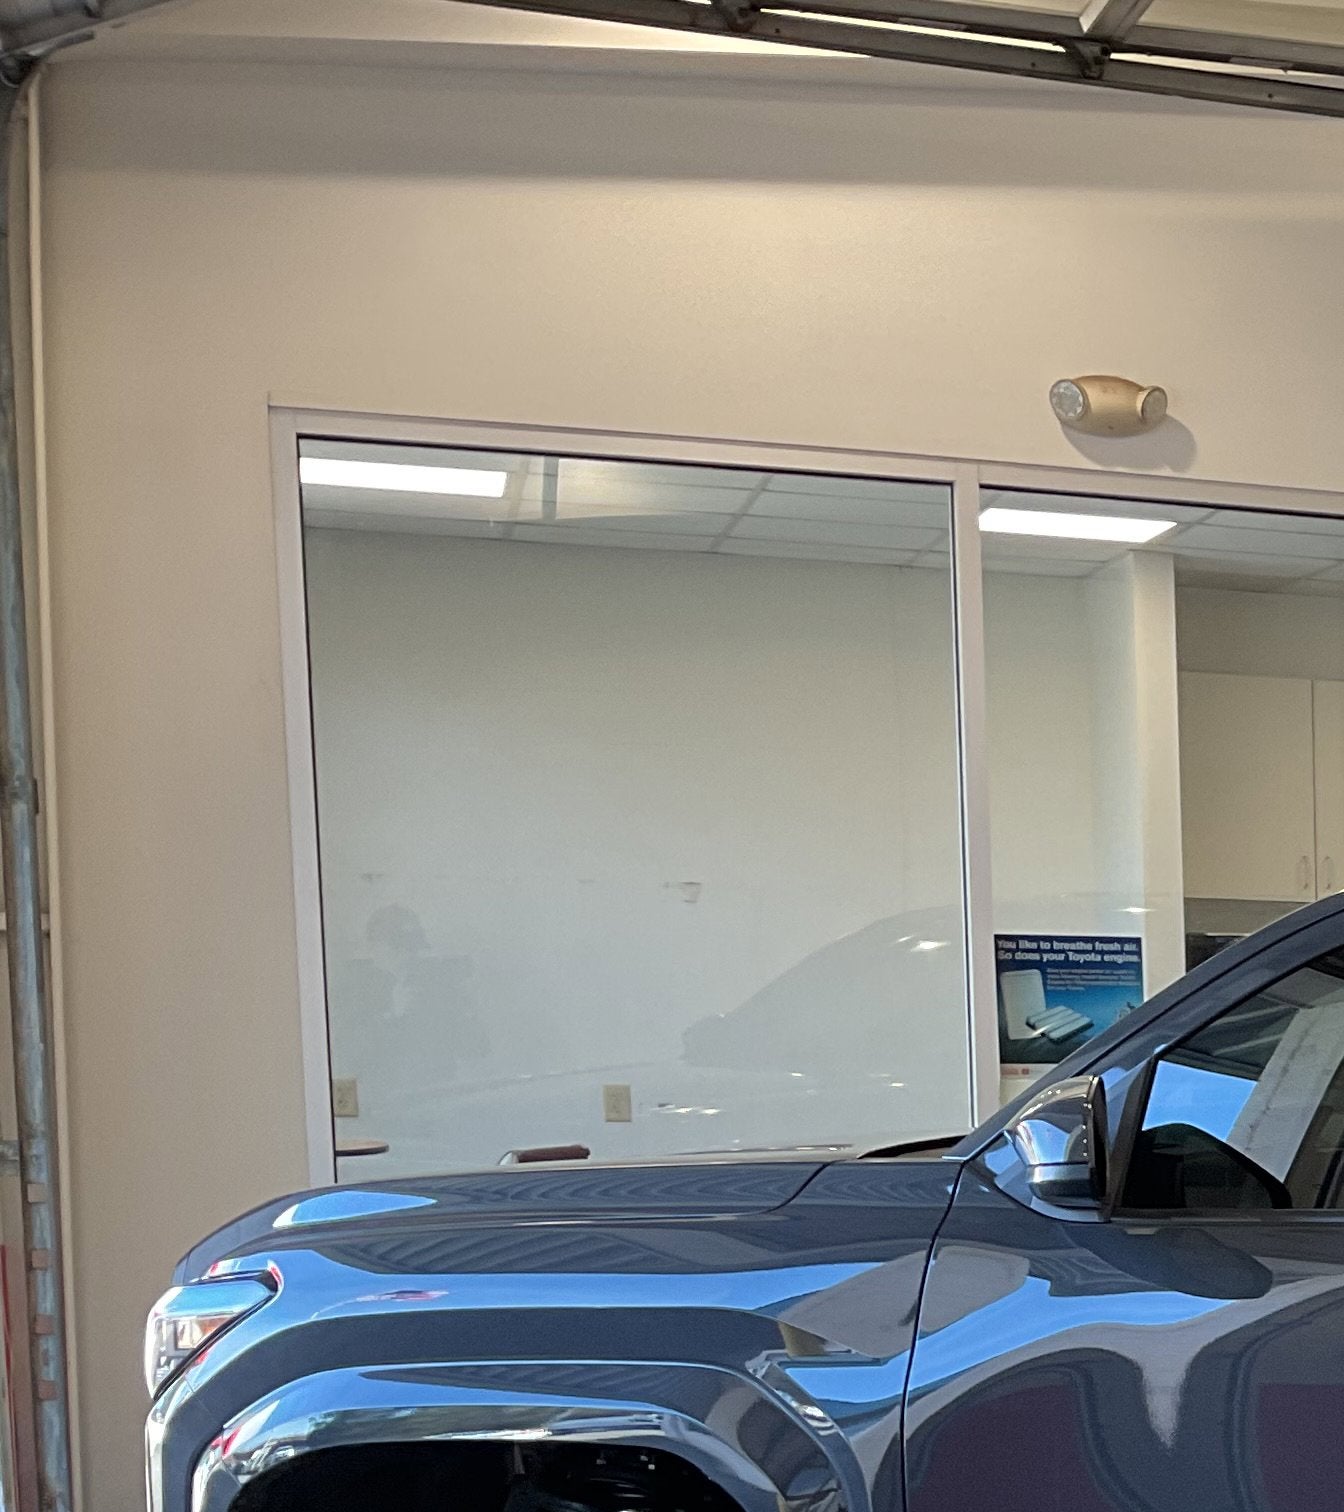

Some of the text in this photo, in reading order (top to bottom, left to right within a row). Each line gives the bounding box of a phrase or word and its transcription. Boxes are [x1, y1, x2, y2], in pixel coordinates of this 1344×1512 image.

[997, 940, 1017, 949] You
[1018, 940, 1038, 949] like
[1040, 940, 1051, 950] to
[1053, 940, 1093, 950] breathe
[1095, 941, 1121, 951] fresh
[997, 950, 1012, 960] So
[1014, 950, 1040, 960] does
[1042, 952, 1066, 963] your
[1067, 951, 1101, 963] Toyota
